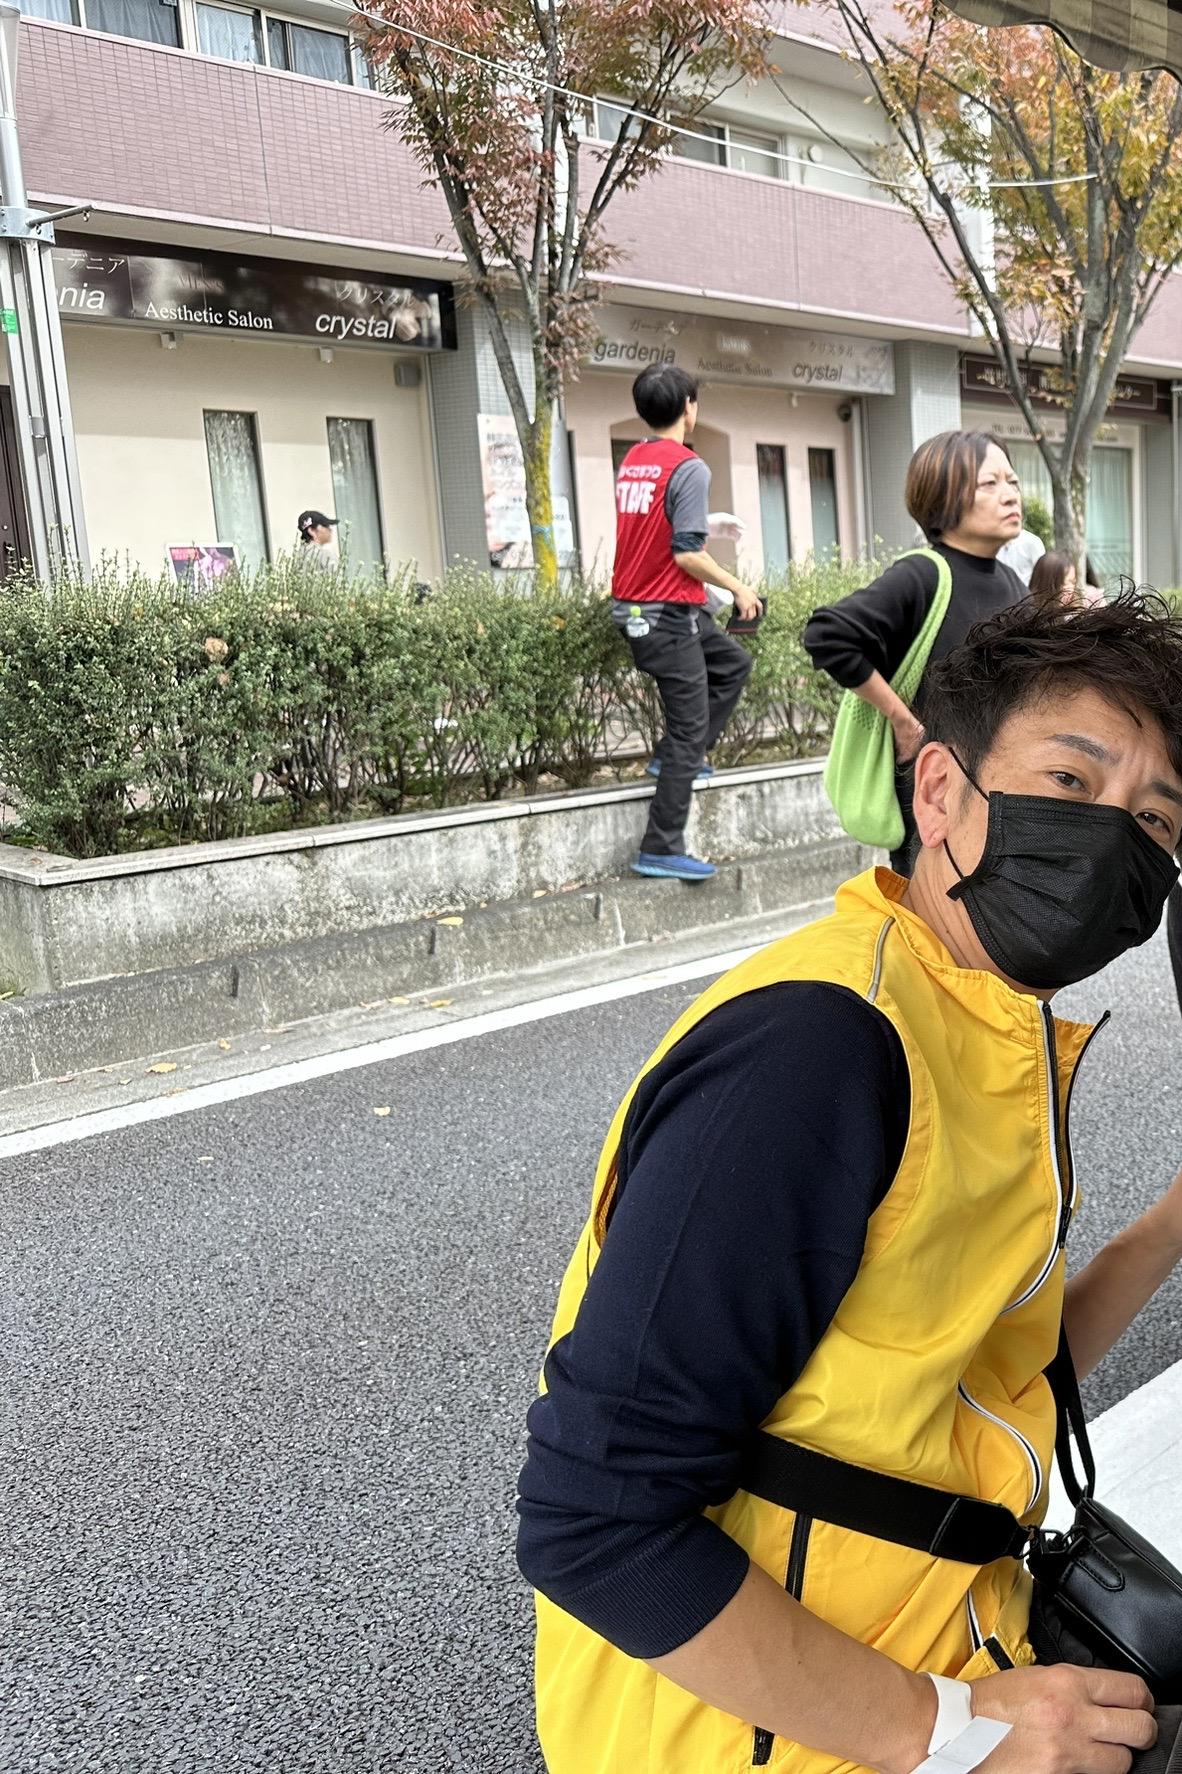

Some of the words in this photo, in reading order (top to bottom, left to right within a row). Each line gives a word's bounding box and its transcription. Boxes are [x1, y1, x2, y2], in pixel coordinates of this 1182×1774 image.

[52, 250, 125, 274] ーデニア
[57, 282, 106, 310] nia
[145, 301, 224, 325] Aesthetic
[228, 309, 273, 330] Salon
[315, 314, 398, 340] crystal
[594, 339, 676, 364] gardenia
[792, 362, 843, 384] crystal
